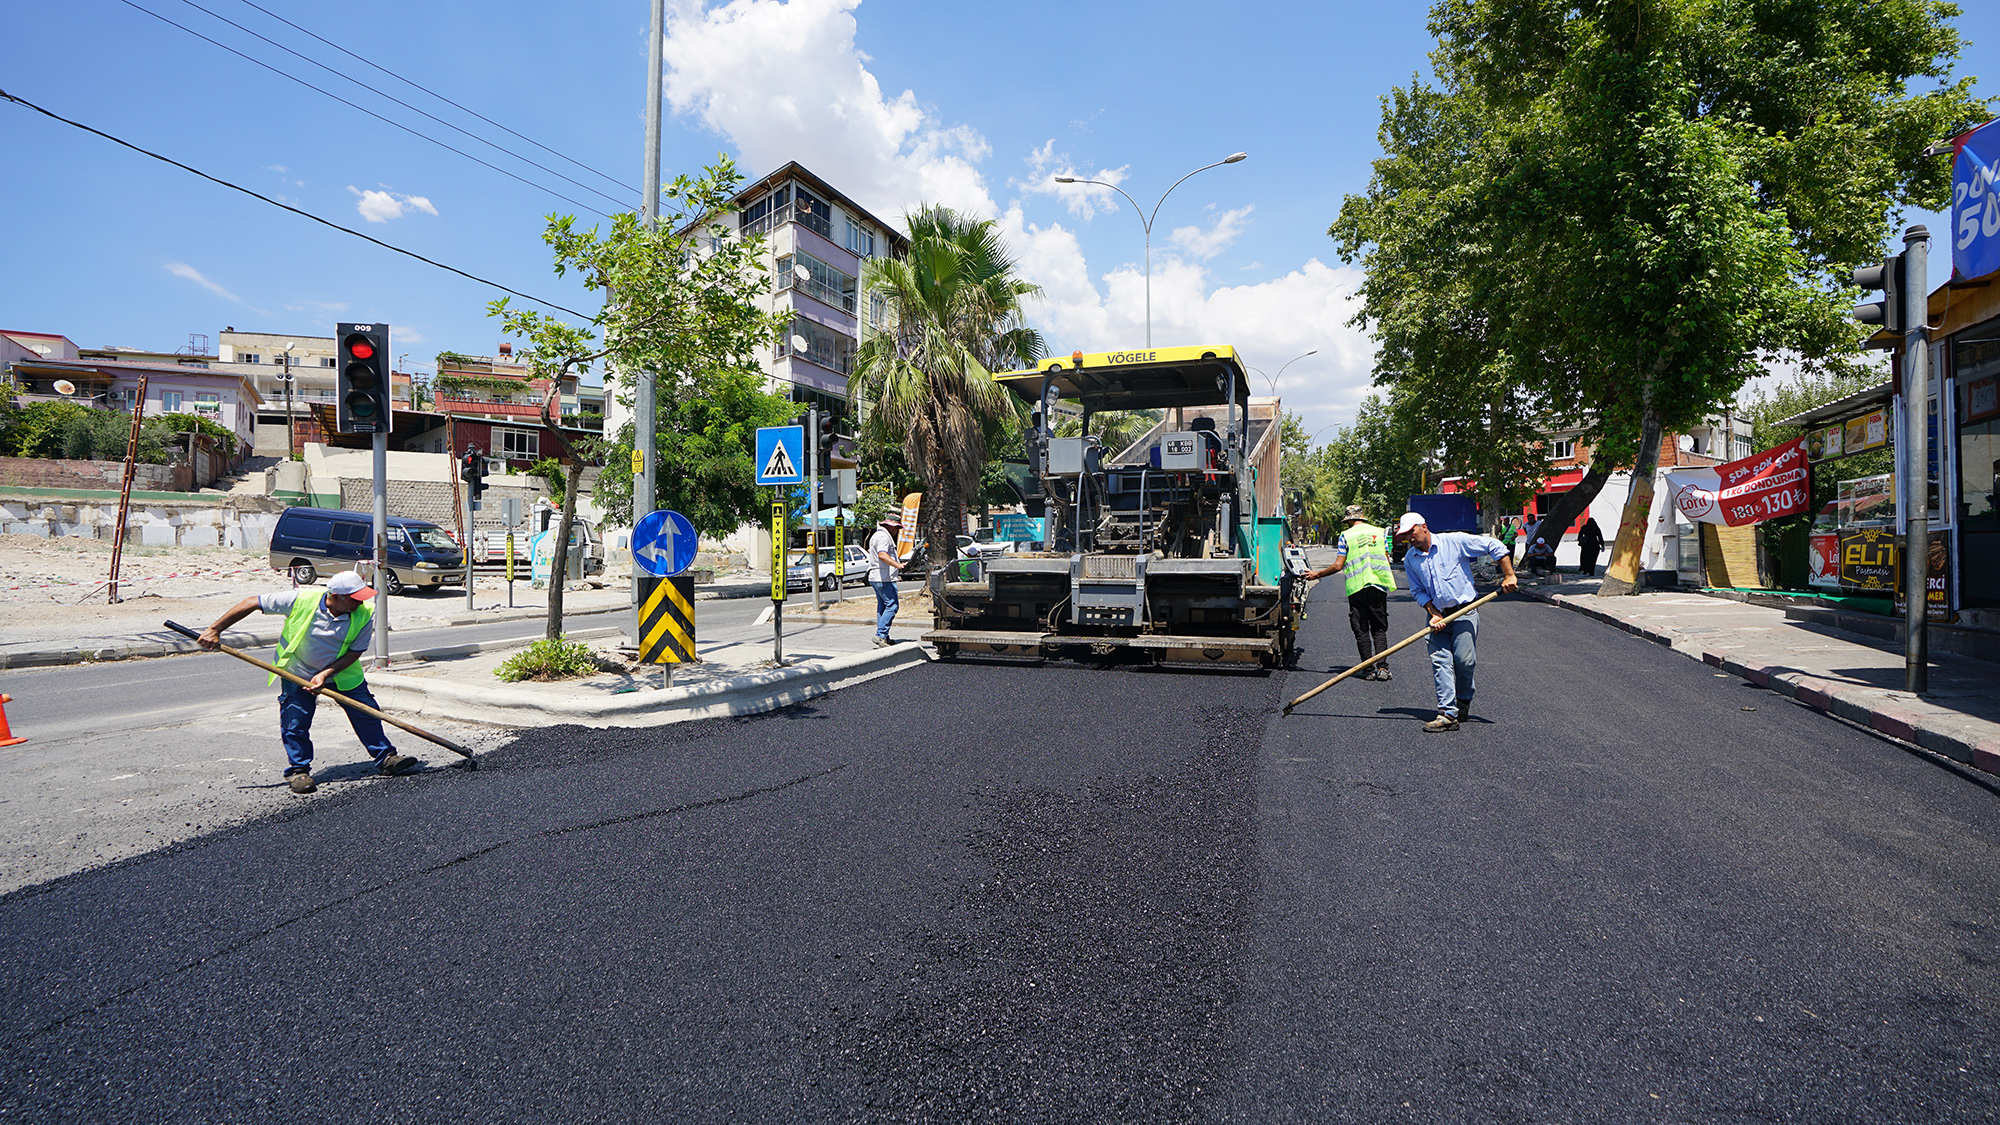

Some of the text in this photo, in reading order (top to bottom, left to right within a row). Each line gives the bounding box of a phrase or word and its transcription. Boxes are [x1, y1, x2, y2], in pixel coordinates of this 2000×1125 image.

[1956, 158, 2000, 209] DÖN
[354, 324, 372, 332] 009
[1107, 351, 1156, 364] VÖGELE
[1753, 457, 1772, 477] ŞOK
[1775, 447, 1799, 468] ŞOK
[1726, 470, 1801, 497] 1 KG DONDURMA
[1679, 493, 1708, 510] Lord
[1855, 566, 1890, 576] Pastanesi
